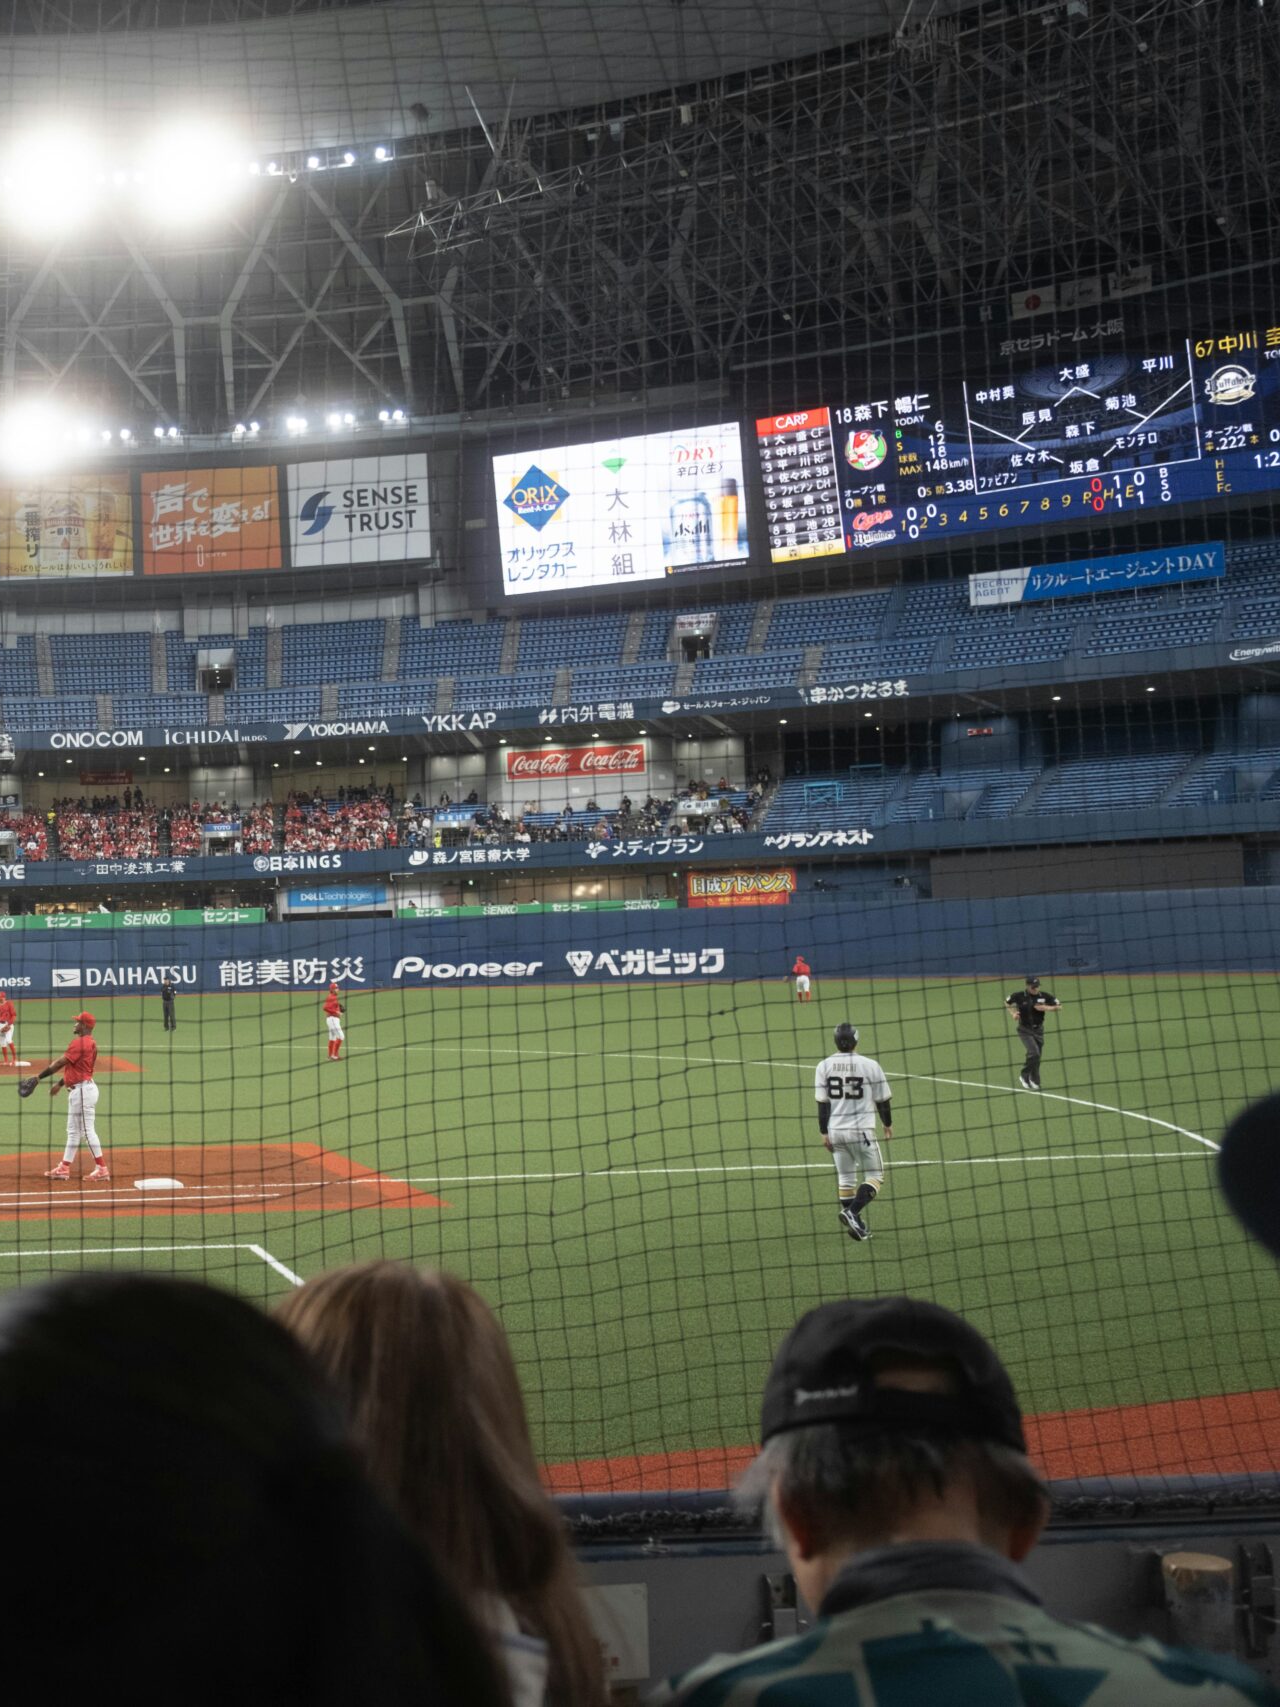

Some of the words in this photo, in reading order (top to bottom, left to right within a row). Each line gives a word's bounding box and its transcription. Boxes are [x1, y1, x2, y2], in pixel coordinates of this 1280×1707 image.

[1195, 339, 1214, 358] 67
[1218, 330, 1258, 354] 中川
[1059, 364, 1090, 382] 大盛
[1142, 355, 1173, 373] 平川
[975, 384, 1015, 403] 中村奨
[1105, 394, 1136, 411] 菊池
[775, 412, 809, 429] CARP
[836, 408, 852, 424] 18
[854, 400, 888, 422] 森下
[894, 415, 925, 427] TODAY
[1021, 409, 1053, 426] 辰見
[763, 437, 768, 446] 1
[811, 428, 824, 438] CF
[896, 430, 902, 439] B
[935, 420, 944, 432] 6
[1065, 421, 1096, 439] 森下
[897, 442, 903, 451] S
[929, 434, 945, 446] 12
[1115, 432, 1158, 449] モンテロ
[763, 450, 771, 459] 2
[814, 441, 825, 451] LF
[930, 447, 947, 458] 18
[1010, 450, 1051, 467] 佐々木
[765, 463, 772, 472] 3
[814, 454, 827, 465] RF
[900, 464, 923, 476] MAX
[1069, 457, 1100, 474] 坂倉
[1215, 459, 1225, 469] H
[767, 475, 773, 484] 4
[779, 469, 811, 483] 佐々木
[816, 466, 829, 477] 3B
[979, 472, 1018, 489] ファビアン
[1159, 467, 1168, 478] B
[1216, 471, 1224, 482] E
[768, 488, 775, 497] 5
[817, 479, 831, 490] DH
[1161, 479, 1169, 490] S
[151, 481, 208, 523] 声で
[343, 485, 419, 509] SENSE
[511, 484, 560, 506] ORIX
[769, 501, 777, 510] 6
[821, 492, 830, 502] C
[906, 507, 917, 520] 0
[926, 504, 937, 518] 0
[1091, 477, 1102, 492] 0
[1113, 475, 1120, 488] 1
[1133, 471, 1145, 486] 0
[517, 503, 557, 514] Rent-A-Car
[771, 513, 778, 523] 7
[784, 507, 816, 520] モンテロ
[821, 504, 834, 515] 1B
[901, 520, 906, 531] 1
[920, 516, 927, 529] 2
[938, 513, 947, 526] 3
[959, 510, 967, 522] 4
[979, 507, 988, 519] 5
[999, 504, 1008, 517] 6
[1020, 501, 1029, 514] 7
[1040, 498, 1050, 510] 8
[1061, 495, 1071, 507] 9
[1082, 492, 1091, 504] R
[1103, 488, 1114, 501] H
[1125, 485, 1134, 498] E
[908, 525, 919, 538] 0
[1092, 496, 1104, 512] 0
[1115, 494, 1122, 508] 1
[1137, 491, 1144, 505] 1
[344, 508, 418, 533] TRUST
[773, 526, 779, 535] 8
[822, 517, 835, 527] 2B
[24, 503, 40, 558] 一番搾り
[605, 488, 635, 576] 大林組
[774, 538, 781, 548] 9
[823, 530, 836, 540] SS
[507, 541, 576, 564] オリックス
[508, 562, 577, 582] レンタカー
[974, 577, 1019, 590] RECRUIT
[975, 586, 1010, 598] AGENT
[810, 680, 909, 704] 串かつだるま
[562, 702, 634, 723] 内外電機
[308, 720, 390, 738] YOKOHAMA
[422, 714, 465, 732] YKK
[469, 712, 496, 729] AP
[50, 730, 143, 748] ONOCOM
[512, 753, 571, 775] Coca-Cola
[580, 748, 641, 771] Coca-Cola
[611, 838, 704, 857] メディプラン
[775, 829, 874, 849] グランアネスト
[432, 847, 530, 865] 森ノ宮医療大学
[300, 892, 324, 902] DELL
[324, 889, 372, 902] Technologies
[415, 907, 448, 918] センコー
[482, 905, 518, 915] SENKO
[624, 900, 659, 910] SENKO
[45, 915, 92, 928] センコー
[122, 912, 171, 926] SENKO
[201, 910, 250, 922] センコー
[392, 956, 542, 980] Pioneer
[594, 948, 725, 976] ベガビック
[86, 965, 197, 987] DAIHATSU
[219, 957, 366, 987] 能美防災
[827, 1076, 864, 1100] 83
